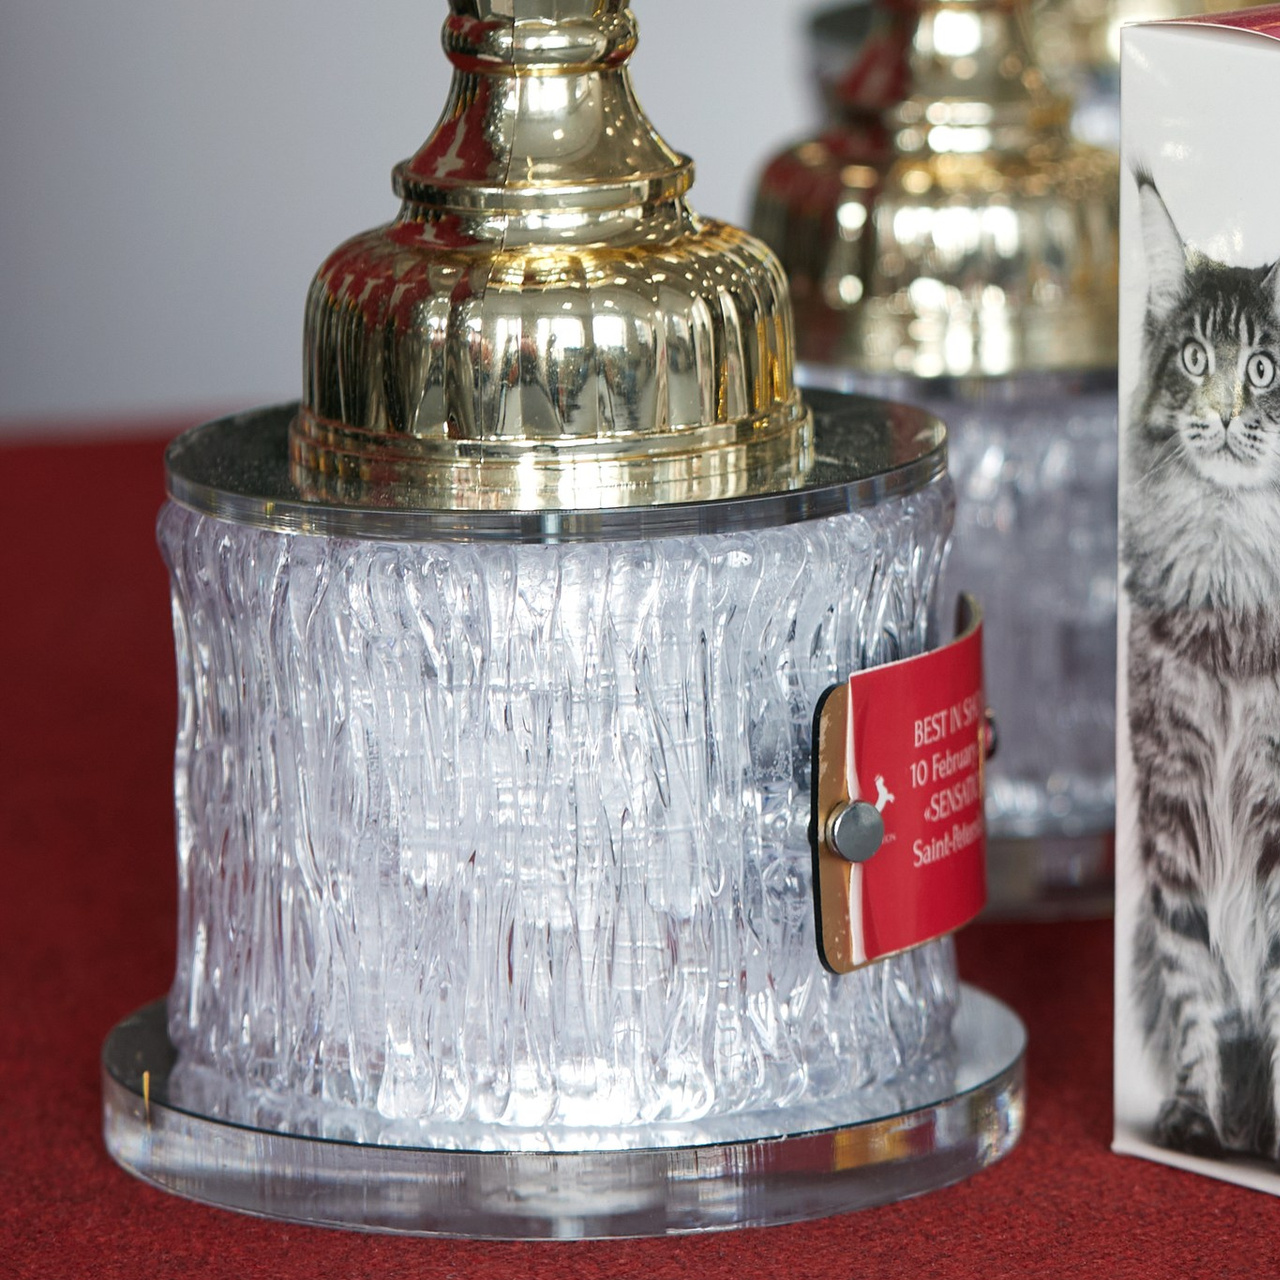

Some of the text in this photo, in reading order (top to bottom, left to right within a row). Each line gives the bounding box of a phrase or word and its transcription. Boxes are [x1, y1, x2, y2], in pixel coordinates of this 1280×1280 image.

[914, 707, 949, 749] BEST
[949, 702, 963, 736] IN
[909, 758, 929, 790] 10
